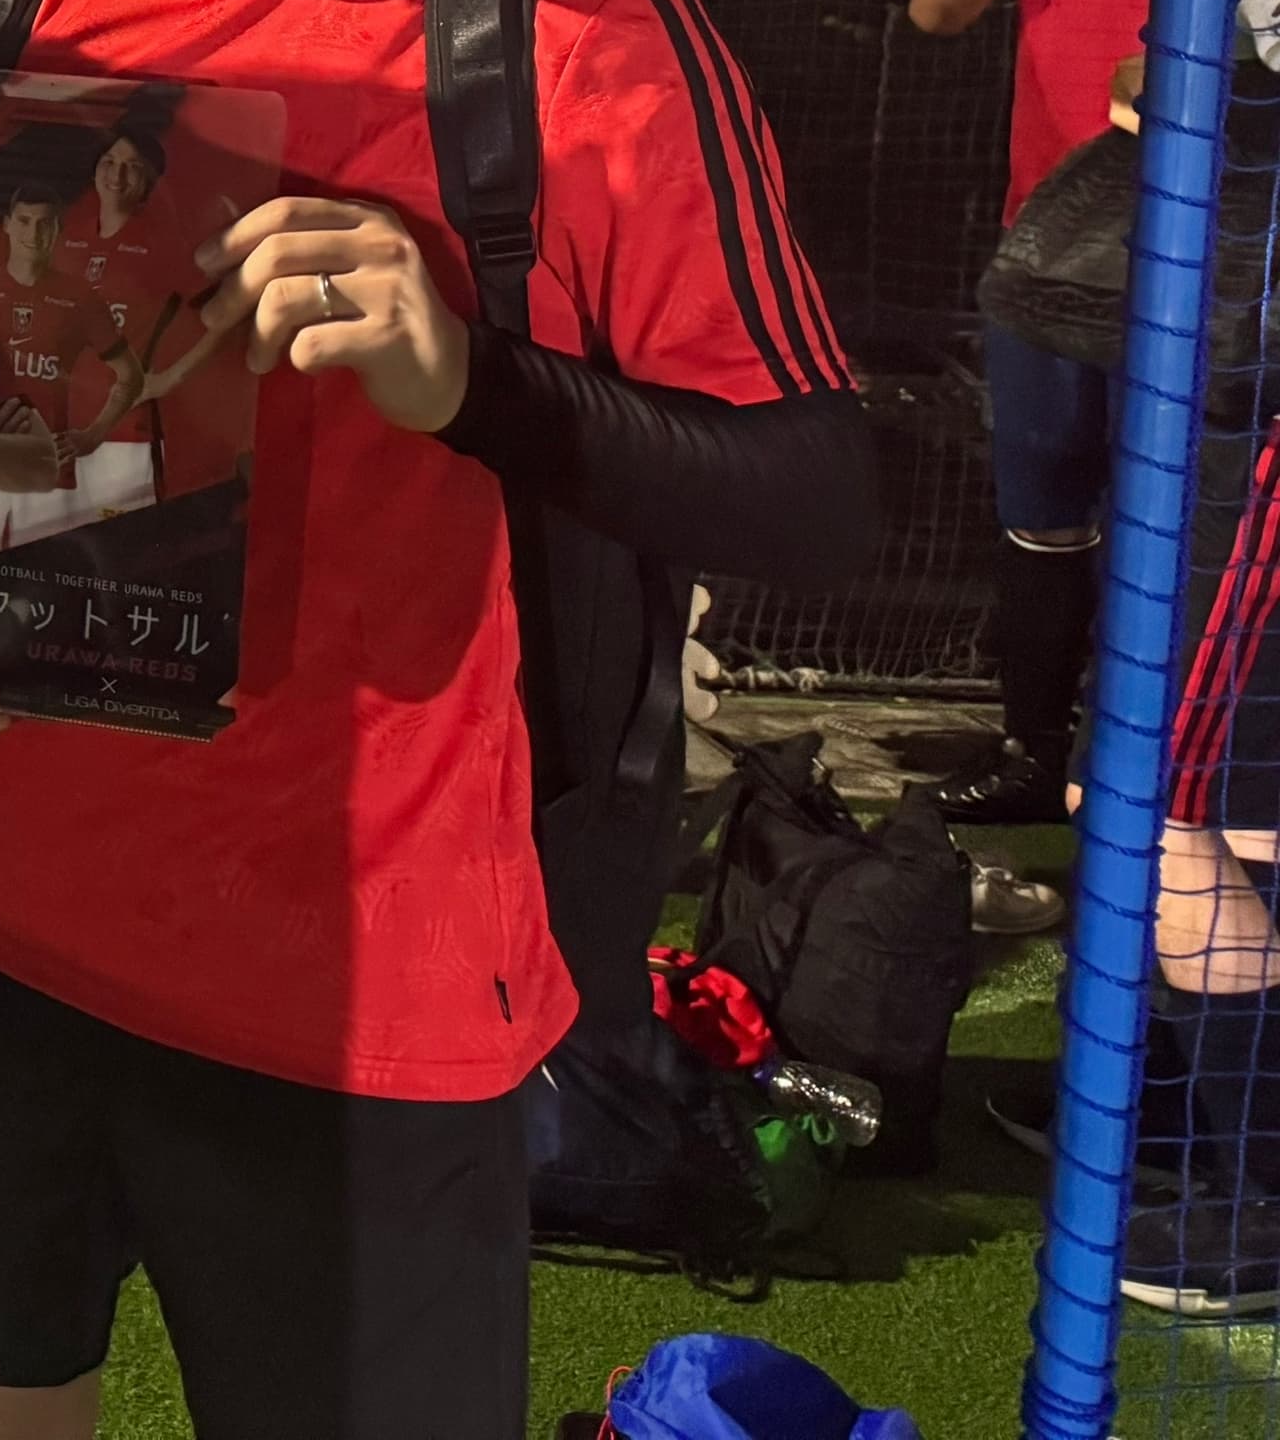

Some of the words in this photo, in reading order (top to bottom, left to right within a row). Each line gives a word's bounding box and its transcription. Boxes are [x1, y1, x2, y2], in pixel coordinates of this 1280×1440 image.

[55, 573, 118, 593] TOGETHER
[124, 583, 165, 600] URAWA
[171, 589, 203, 604] REDS
[27, 642, 117, 671] URAWA
[129, 658, 199, 682] REDS
